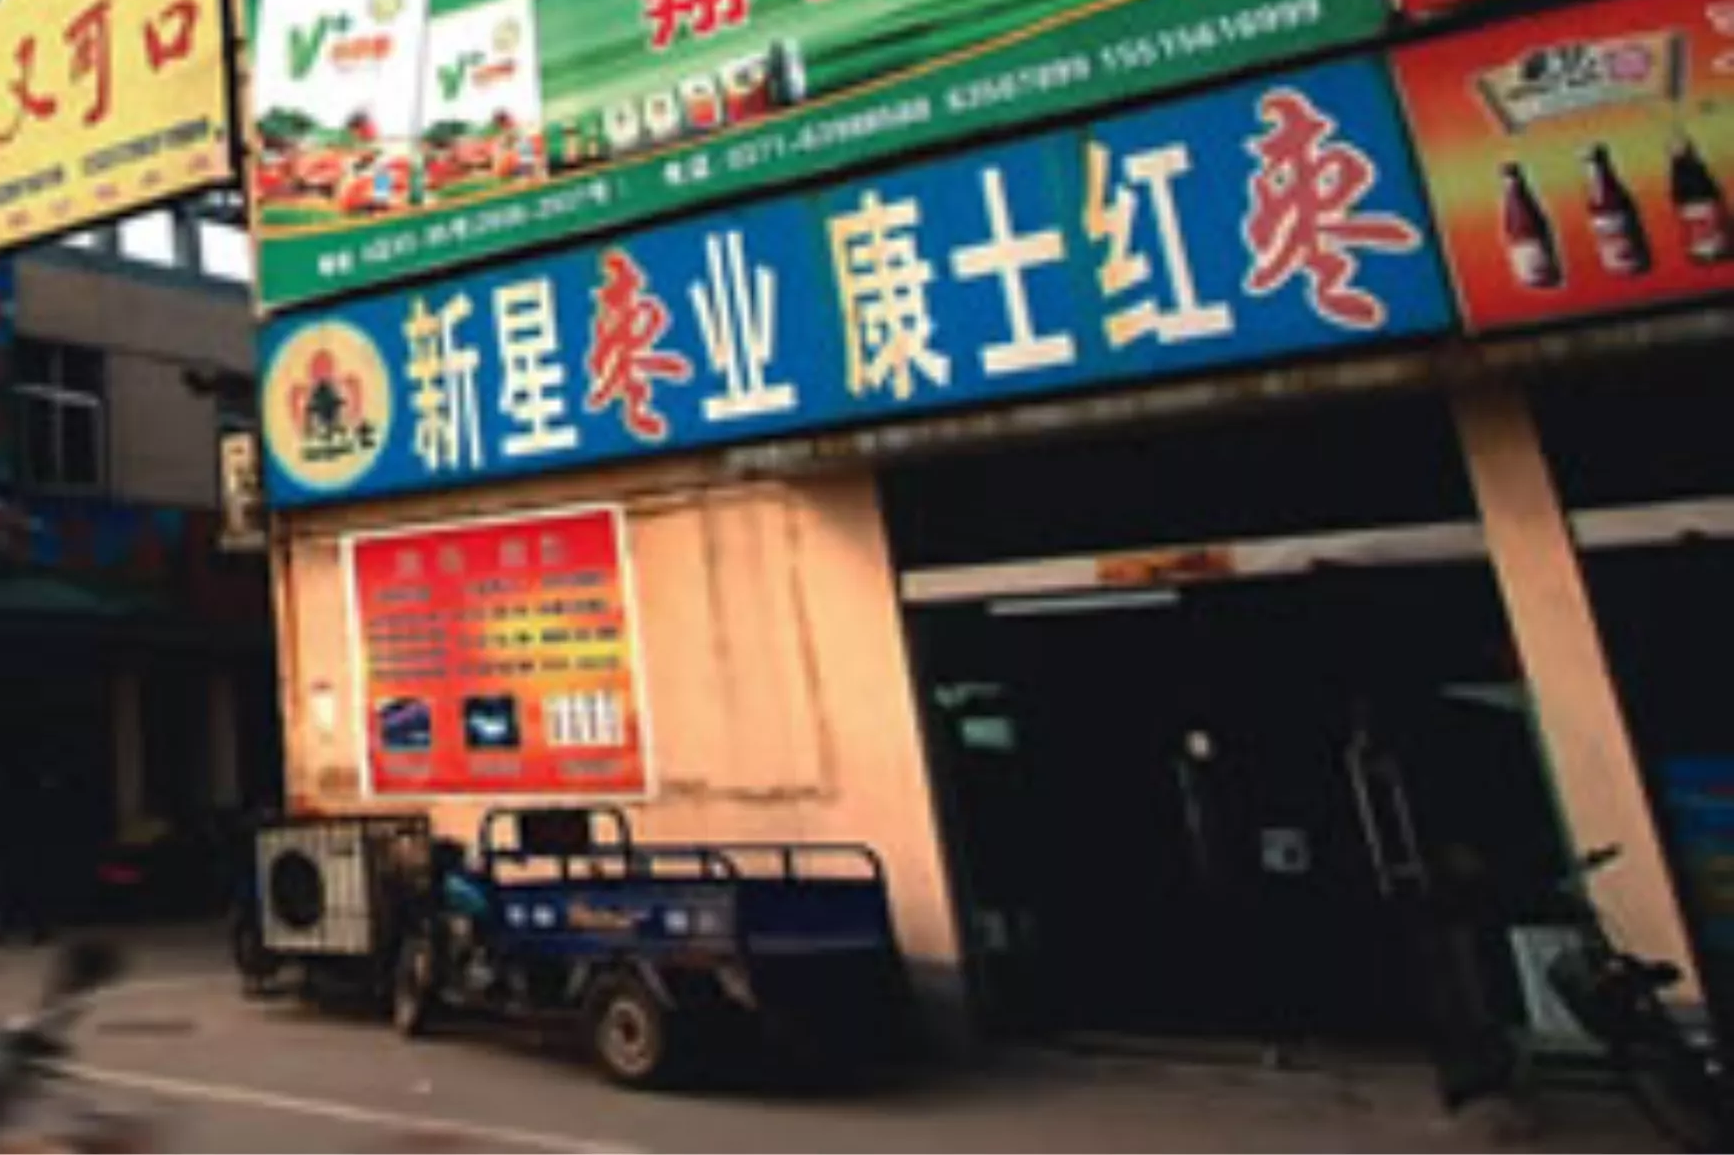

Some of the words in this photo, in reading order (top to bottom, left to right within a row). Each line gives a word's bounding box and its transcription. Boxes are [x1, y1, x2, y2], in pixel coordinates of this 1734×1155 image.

[403, 230, 798, 470] 新星枣业
[826, 86, 1420, 401] 康士红枣
